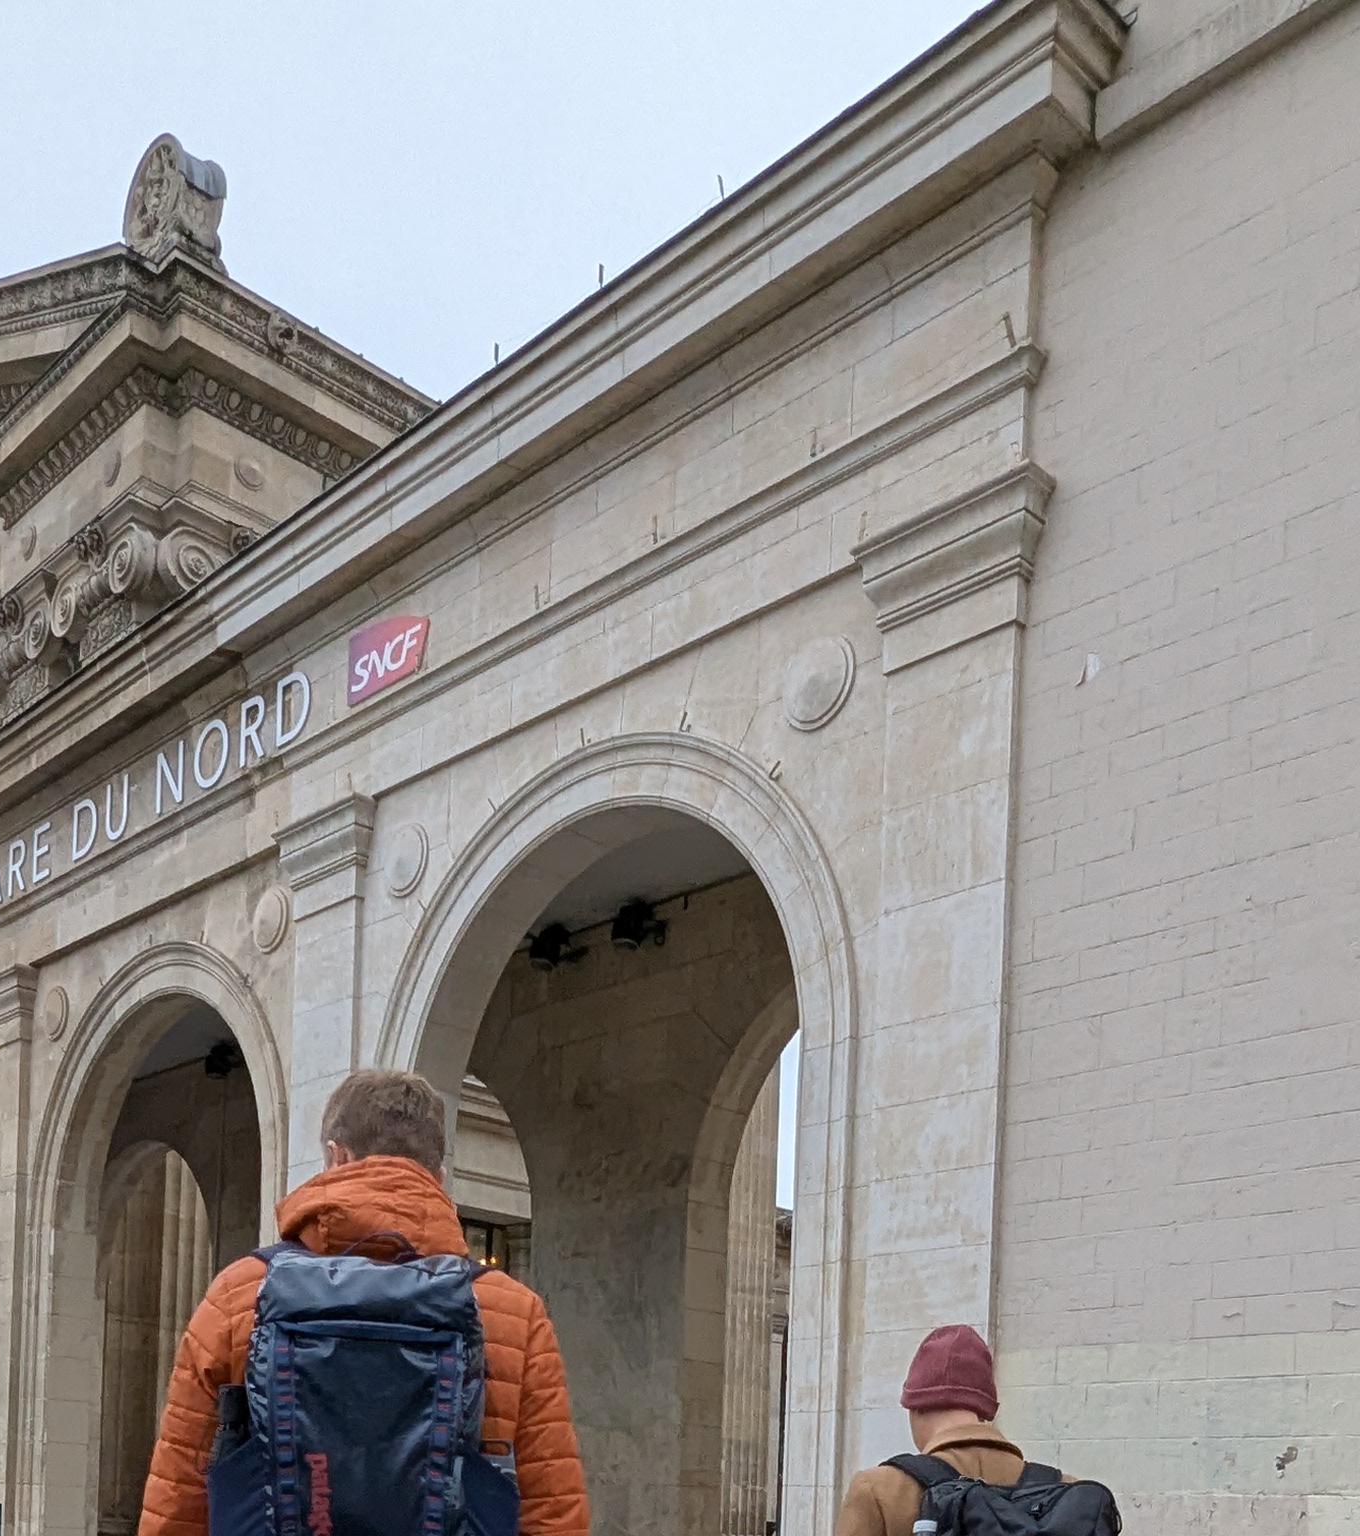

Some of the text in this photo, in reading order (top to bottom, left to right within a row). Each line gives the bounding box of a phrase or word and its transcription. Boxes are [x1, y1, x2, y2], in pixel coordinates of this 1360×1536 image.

[351, 624, 423, 693] SNCF
[72, 774, 130, 862] DU
[154, 671, 311, 814] NORD
